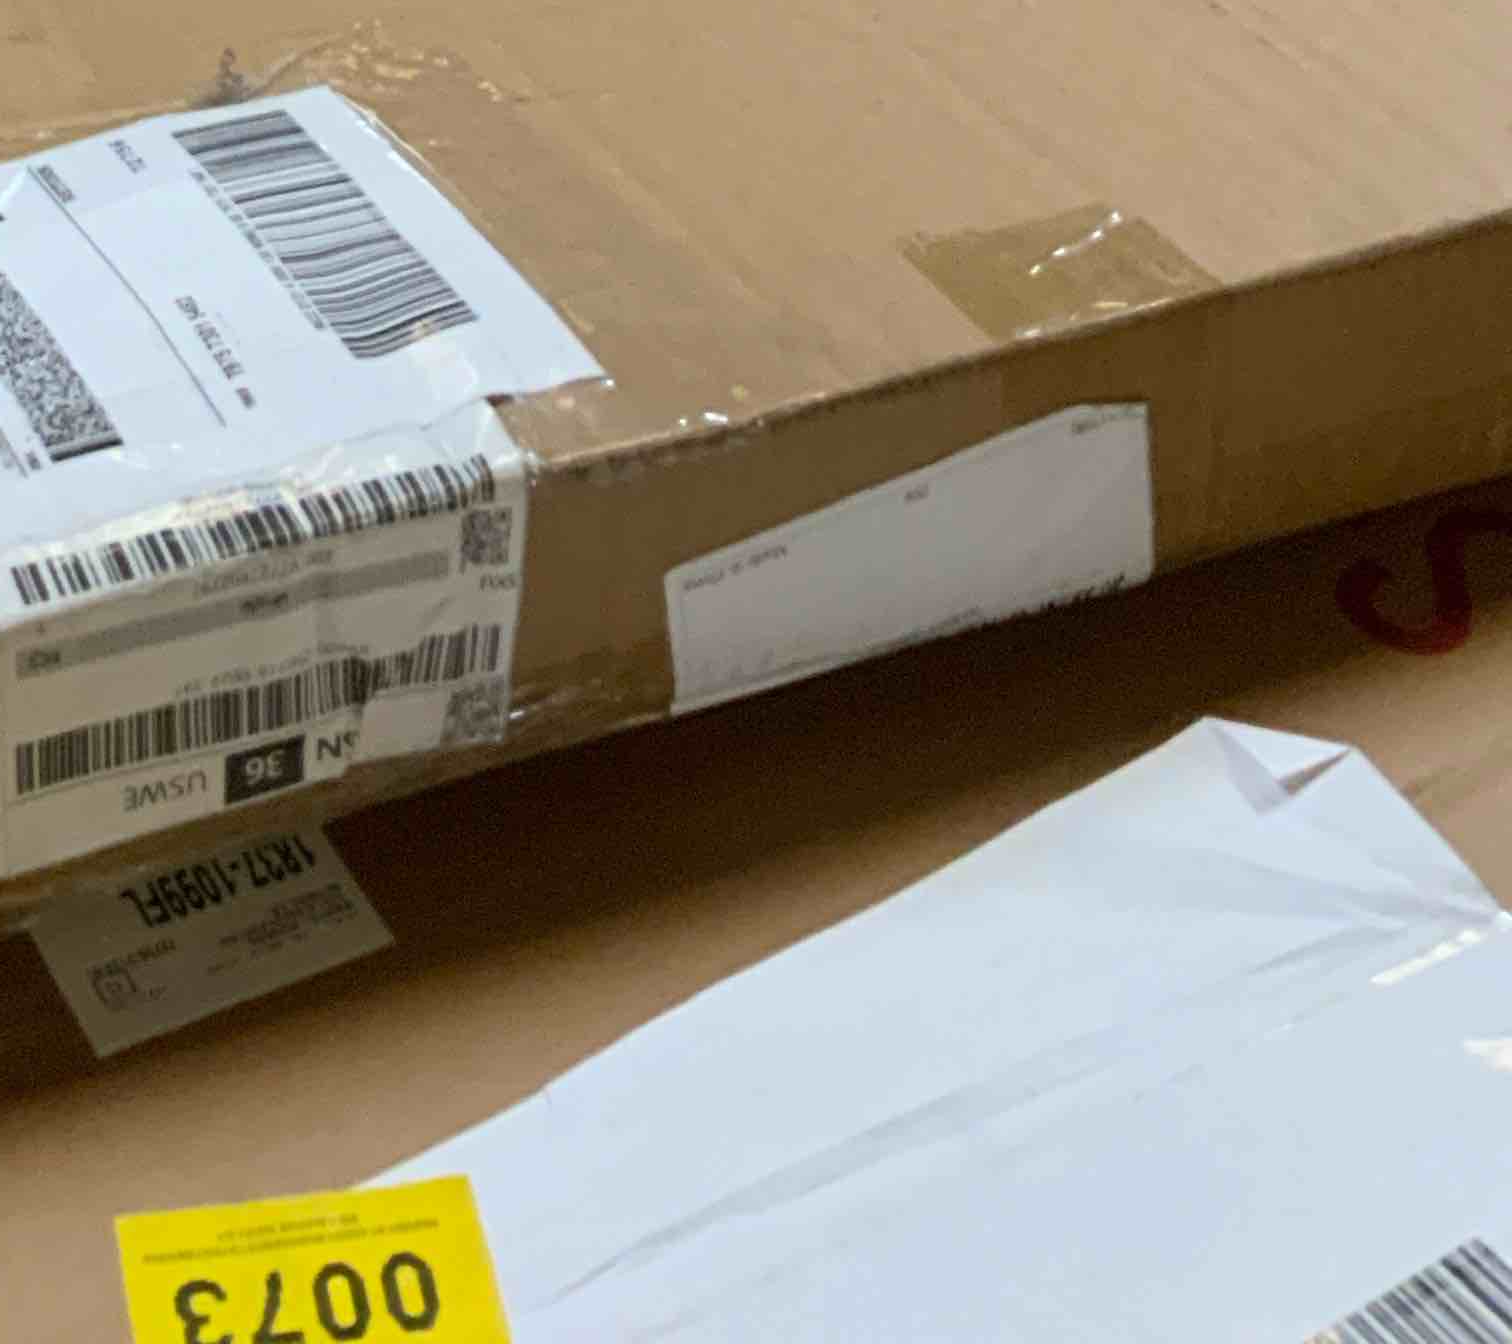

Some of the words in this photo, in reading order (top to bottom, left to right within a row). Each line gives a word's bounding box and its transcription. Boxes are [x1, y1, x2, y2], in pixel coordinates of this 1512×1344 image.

[245, 749, 289, 786] 36
[122, 768, 208, 813] USWE
[173, 1250, 441, 1344] 0073
